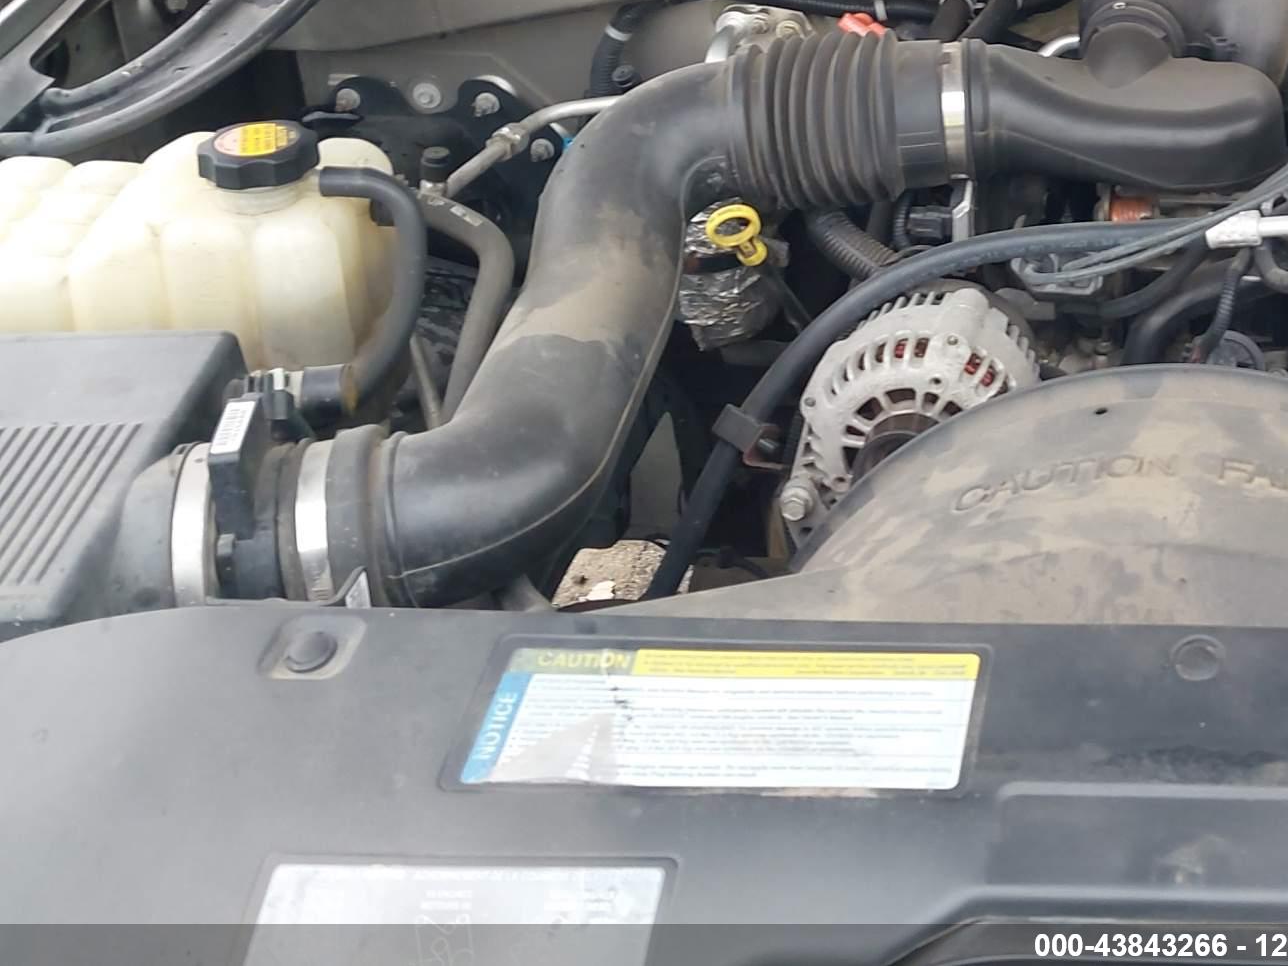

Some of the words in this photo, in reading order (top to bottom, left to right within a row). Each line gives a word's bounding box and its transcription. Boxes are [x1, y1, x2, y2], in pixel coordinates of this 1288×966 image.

[952, 454, 1179, 512] CAUTION
[536, 651, 631, 669] CAUTION
[471, 691, 519, 761] NOTICE
